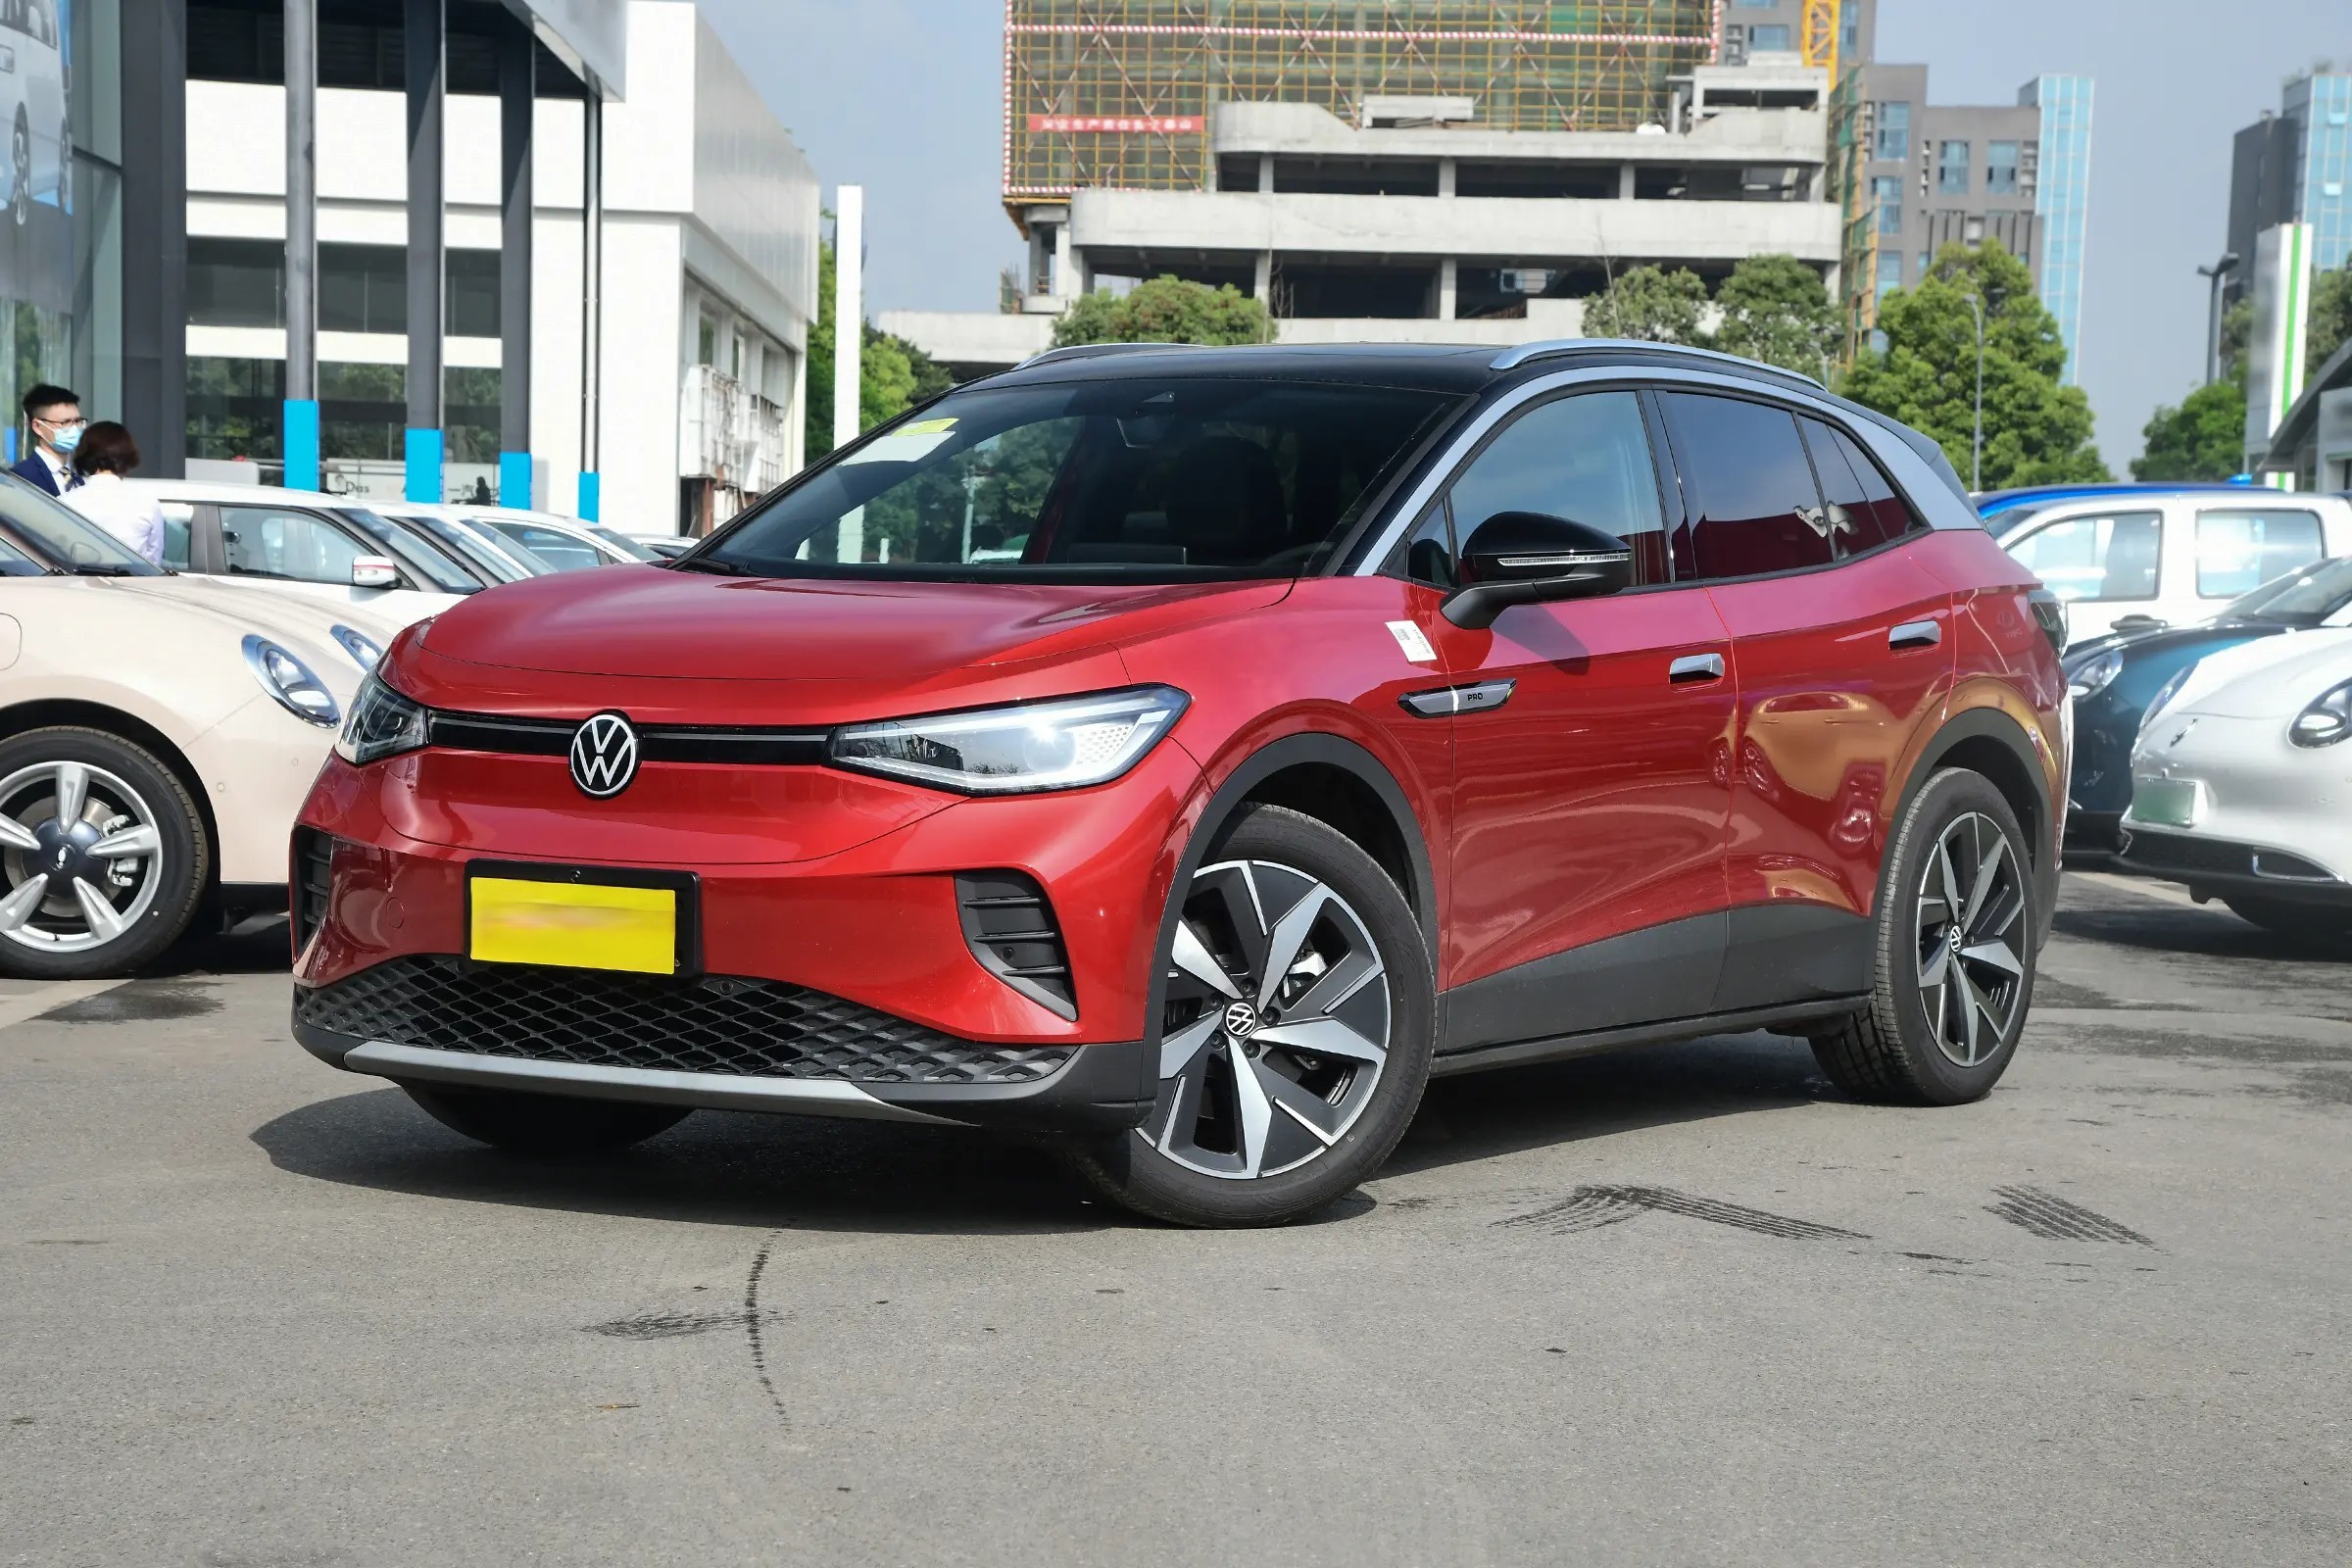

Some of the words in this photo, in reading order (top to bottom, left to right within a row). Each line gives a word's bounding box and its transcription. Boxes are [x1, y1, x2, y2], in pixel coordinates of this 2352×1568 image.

[345, 480, 369, 494] Das
[1467, 692, 1483, 701] PRO
[571, 714, 635, 793] VW
